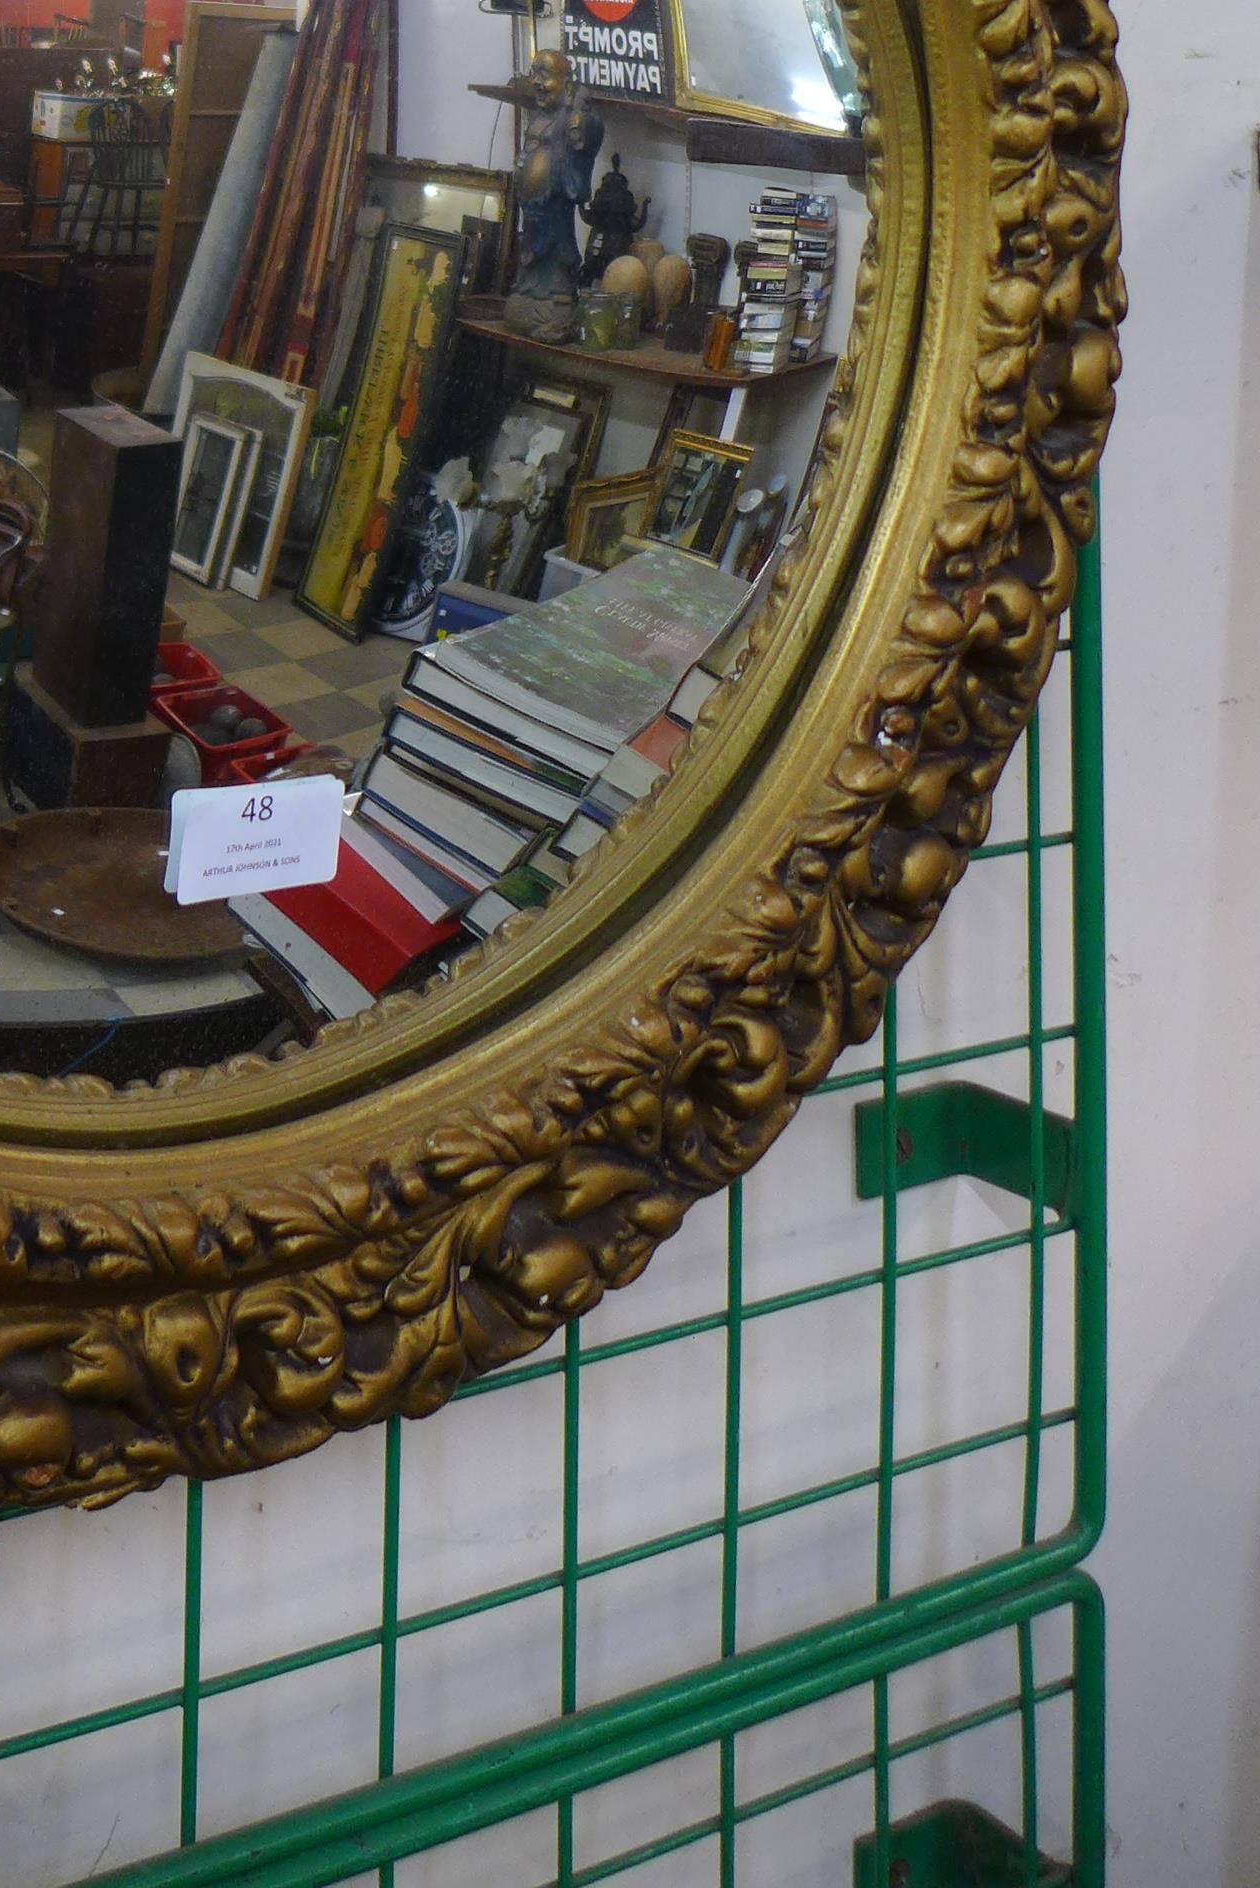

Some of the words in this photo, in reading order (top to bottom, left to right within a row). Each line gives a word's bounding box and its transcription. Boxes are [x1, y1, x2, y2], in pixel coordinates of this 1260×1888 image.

[241, 795, 274, 823] 48
[226, 842, 243, 854] 17th
[244, 840, 263, 852] April
[264, 838, 282, 848] 2021
[202, 865, 234, 878] ARTHUR
[234, 860, 271, 873] JOHNSON
[272, 858, 279, 867] &
[280, 855, 300, 866] SONS
